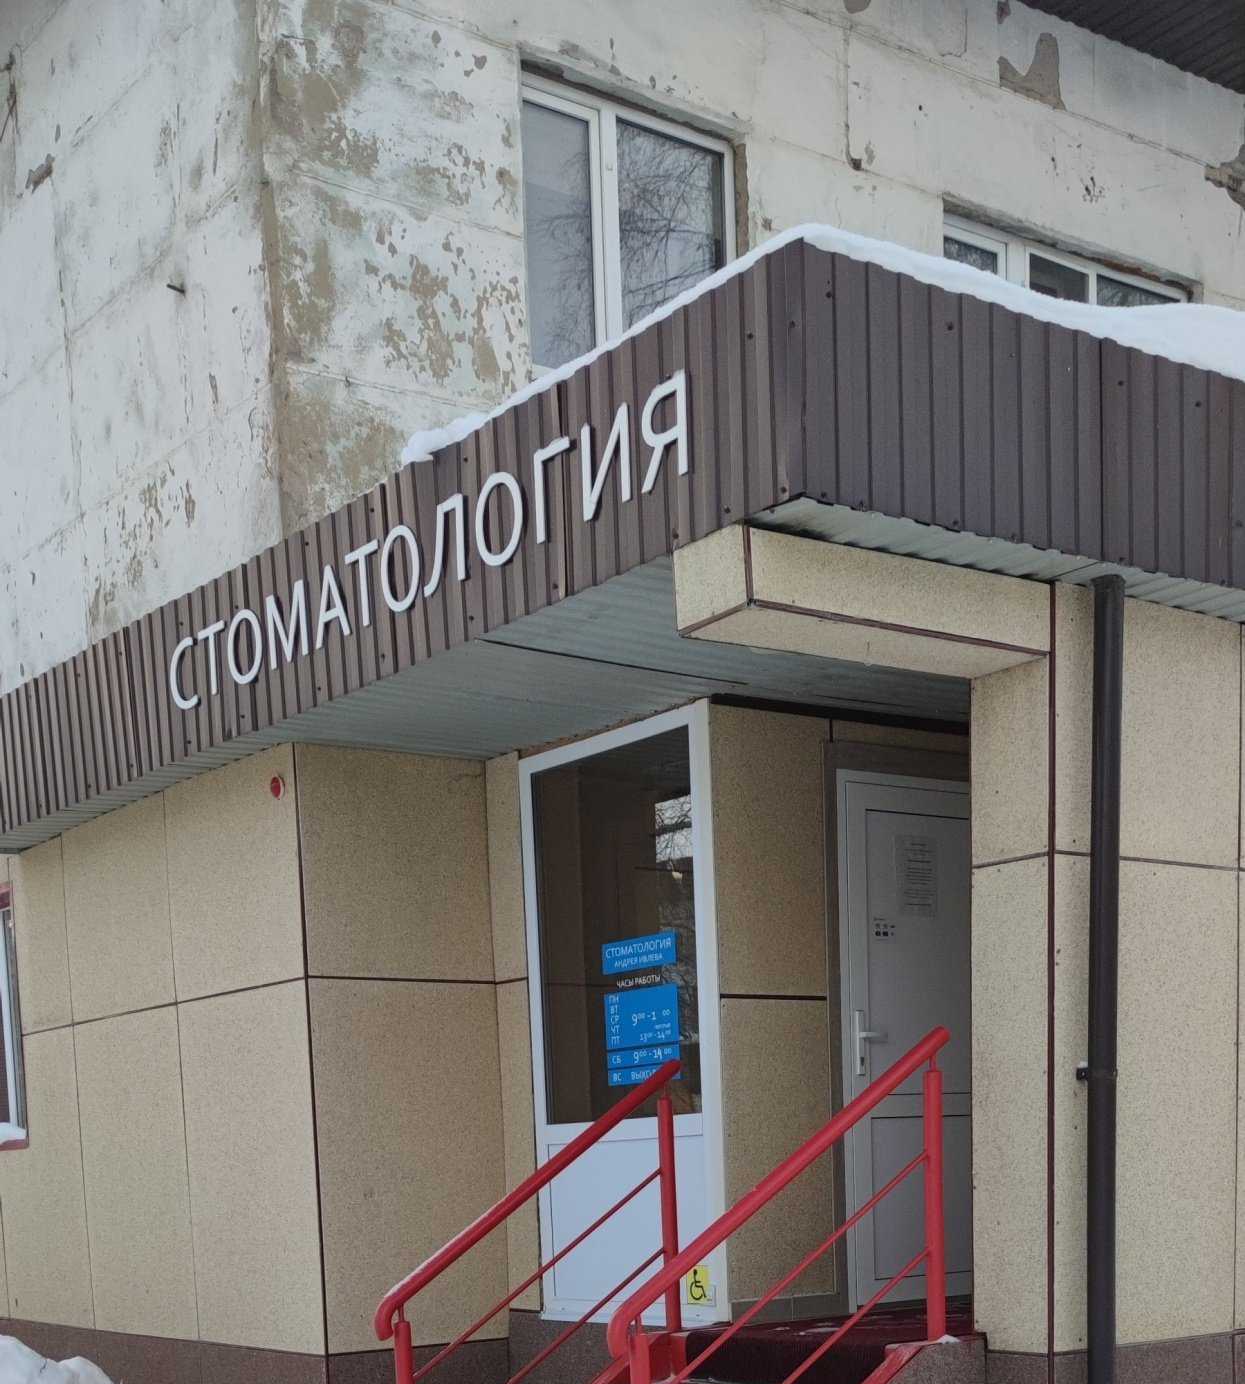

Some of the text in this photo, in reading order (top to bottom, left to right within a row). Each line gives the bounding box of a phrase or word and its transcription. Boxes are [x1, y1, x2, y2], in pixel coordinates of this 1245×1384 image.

[168, 368, 690, 711] СТОМАТОЛОГИЯ
[605, 937, 672, 958] СТОМАТОЛОГИЯ
[616, 974, 661, 988] ЧАСЫ РАБОТЫ
[608, 994, 620, 1004] ПН
[610, 1004, 618, 1014] ВТ
[610, 1015, 619, 1025] СР
[611, 1025, 620, 1035] ЧТ
[611, 1035, 620, 1046] ПТ
[612, 1055, 622, 1065] СБ
[613, 1073, 622, 1082] ВС
